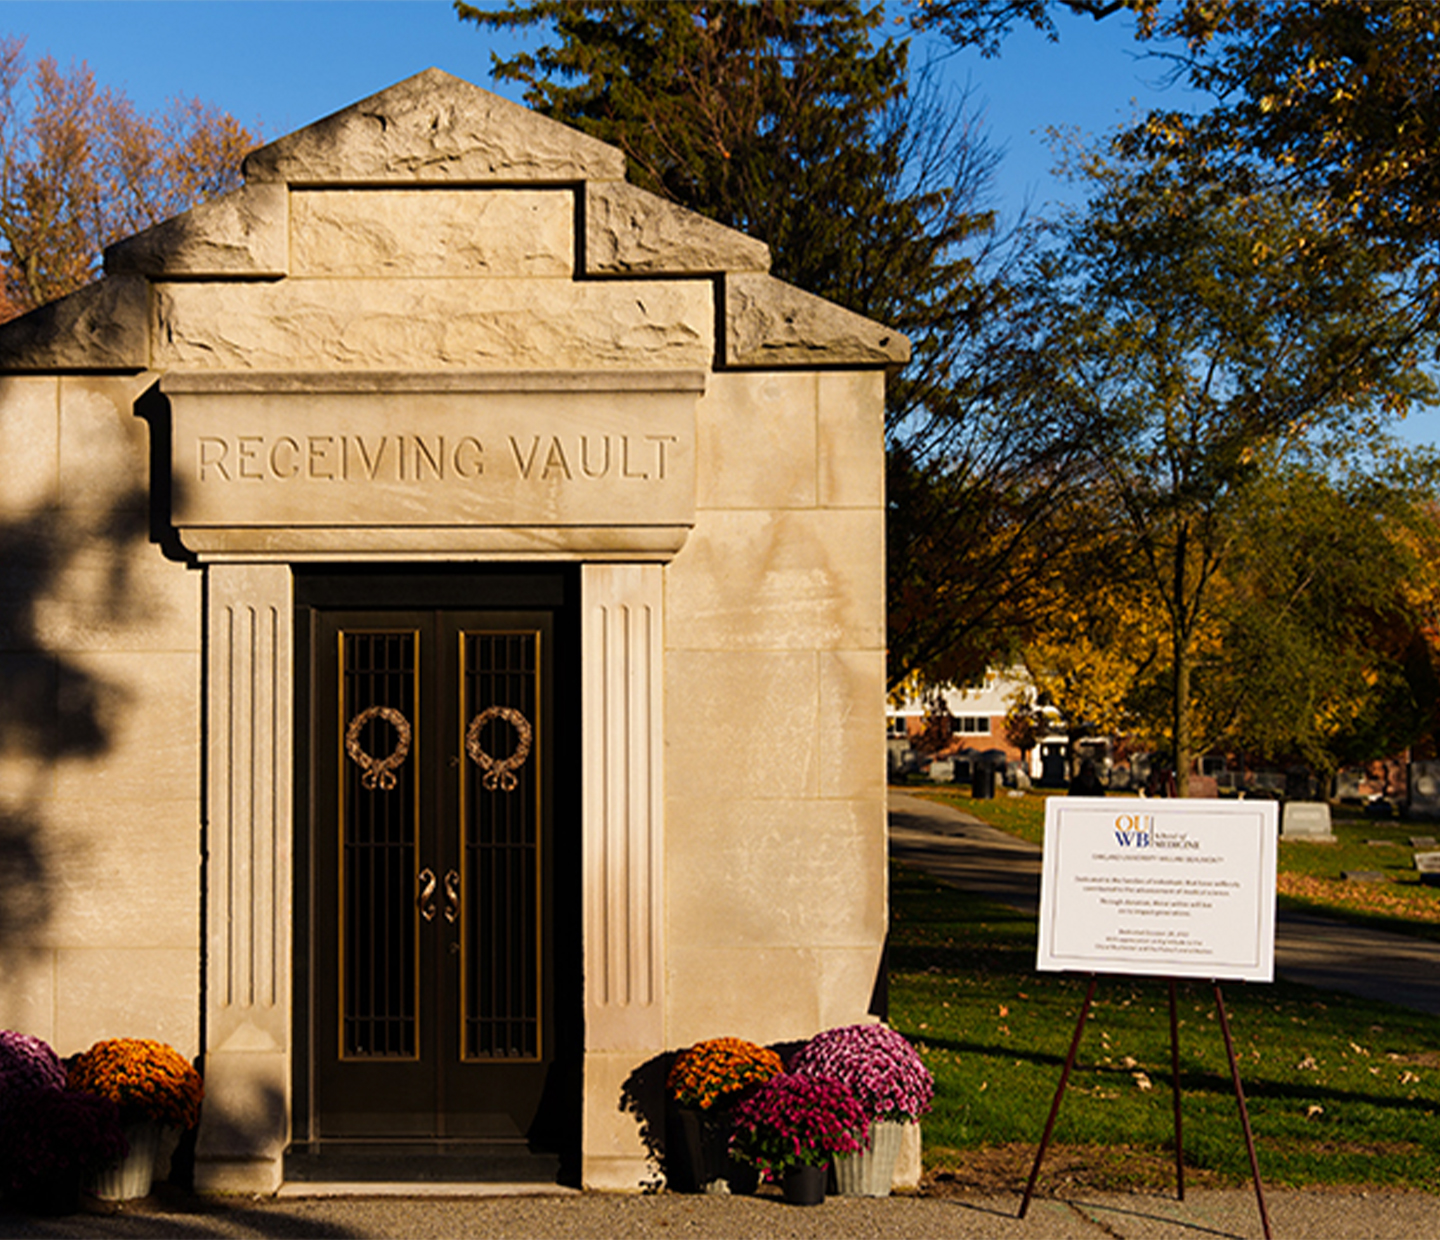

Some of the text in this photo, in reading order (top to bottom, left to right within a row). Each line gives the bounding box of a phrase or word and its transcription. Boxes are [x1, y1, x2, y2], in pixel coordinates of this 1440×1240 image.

[197, 433, 678, 483] RECEIVING VAULT
[1114, 814, 1150, 832] OU
[1114, 830, 1150, 848] WB
